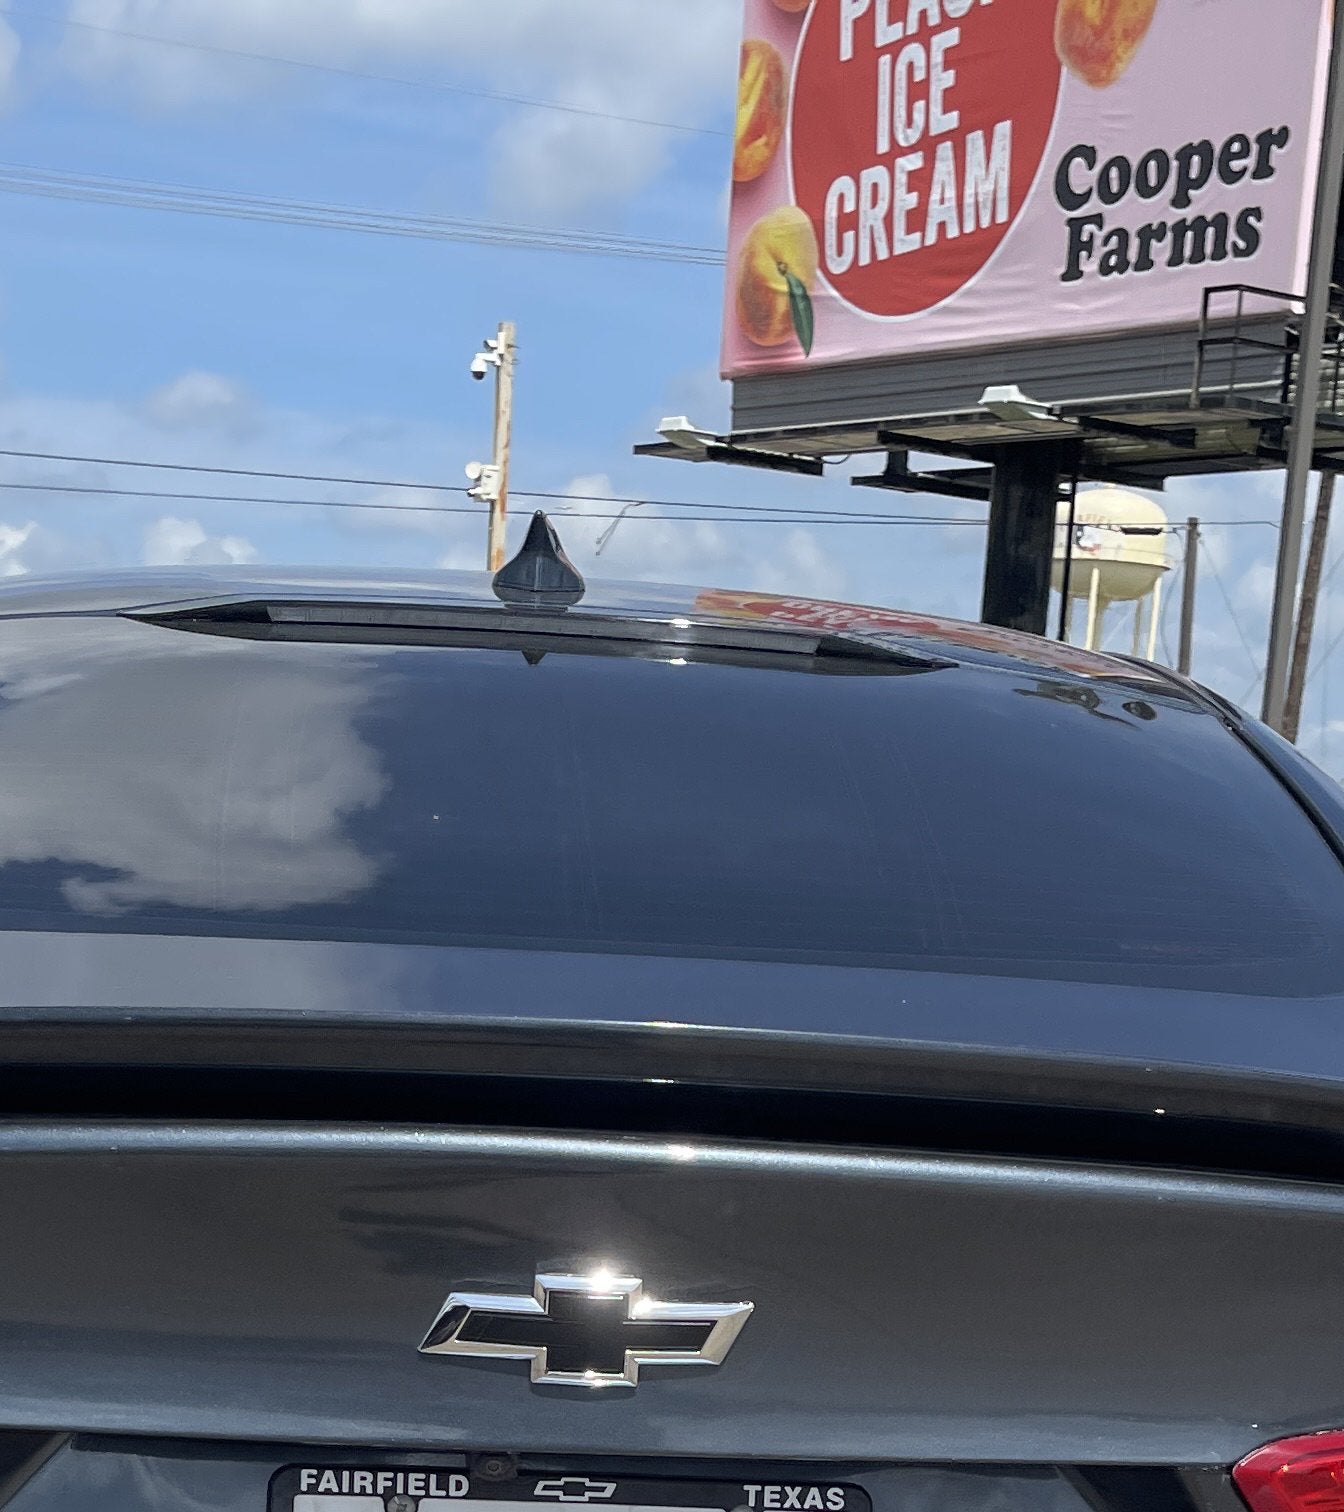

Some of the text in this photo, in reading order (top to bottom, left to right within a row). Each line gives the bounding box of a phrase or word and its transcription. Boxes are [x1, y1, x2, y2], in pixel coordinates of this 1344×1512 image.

[876, 27, 960, 155] ICE
[824, 120, 1013, 275] CREAM
[1054, 125, 1290, 210] Cooper
[1059, 206, 1262, 282] Farms
[300, 1468, 470, 1497] FAIRFIELD
[743, 1484, 845, 1511] TEXAS
